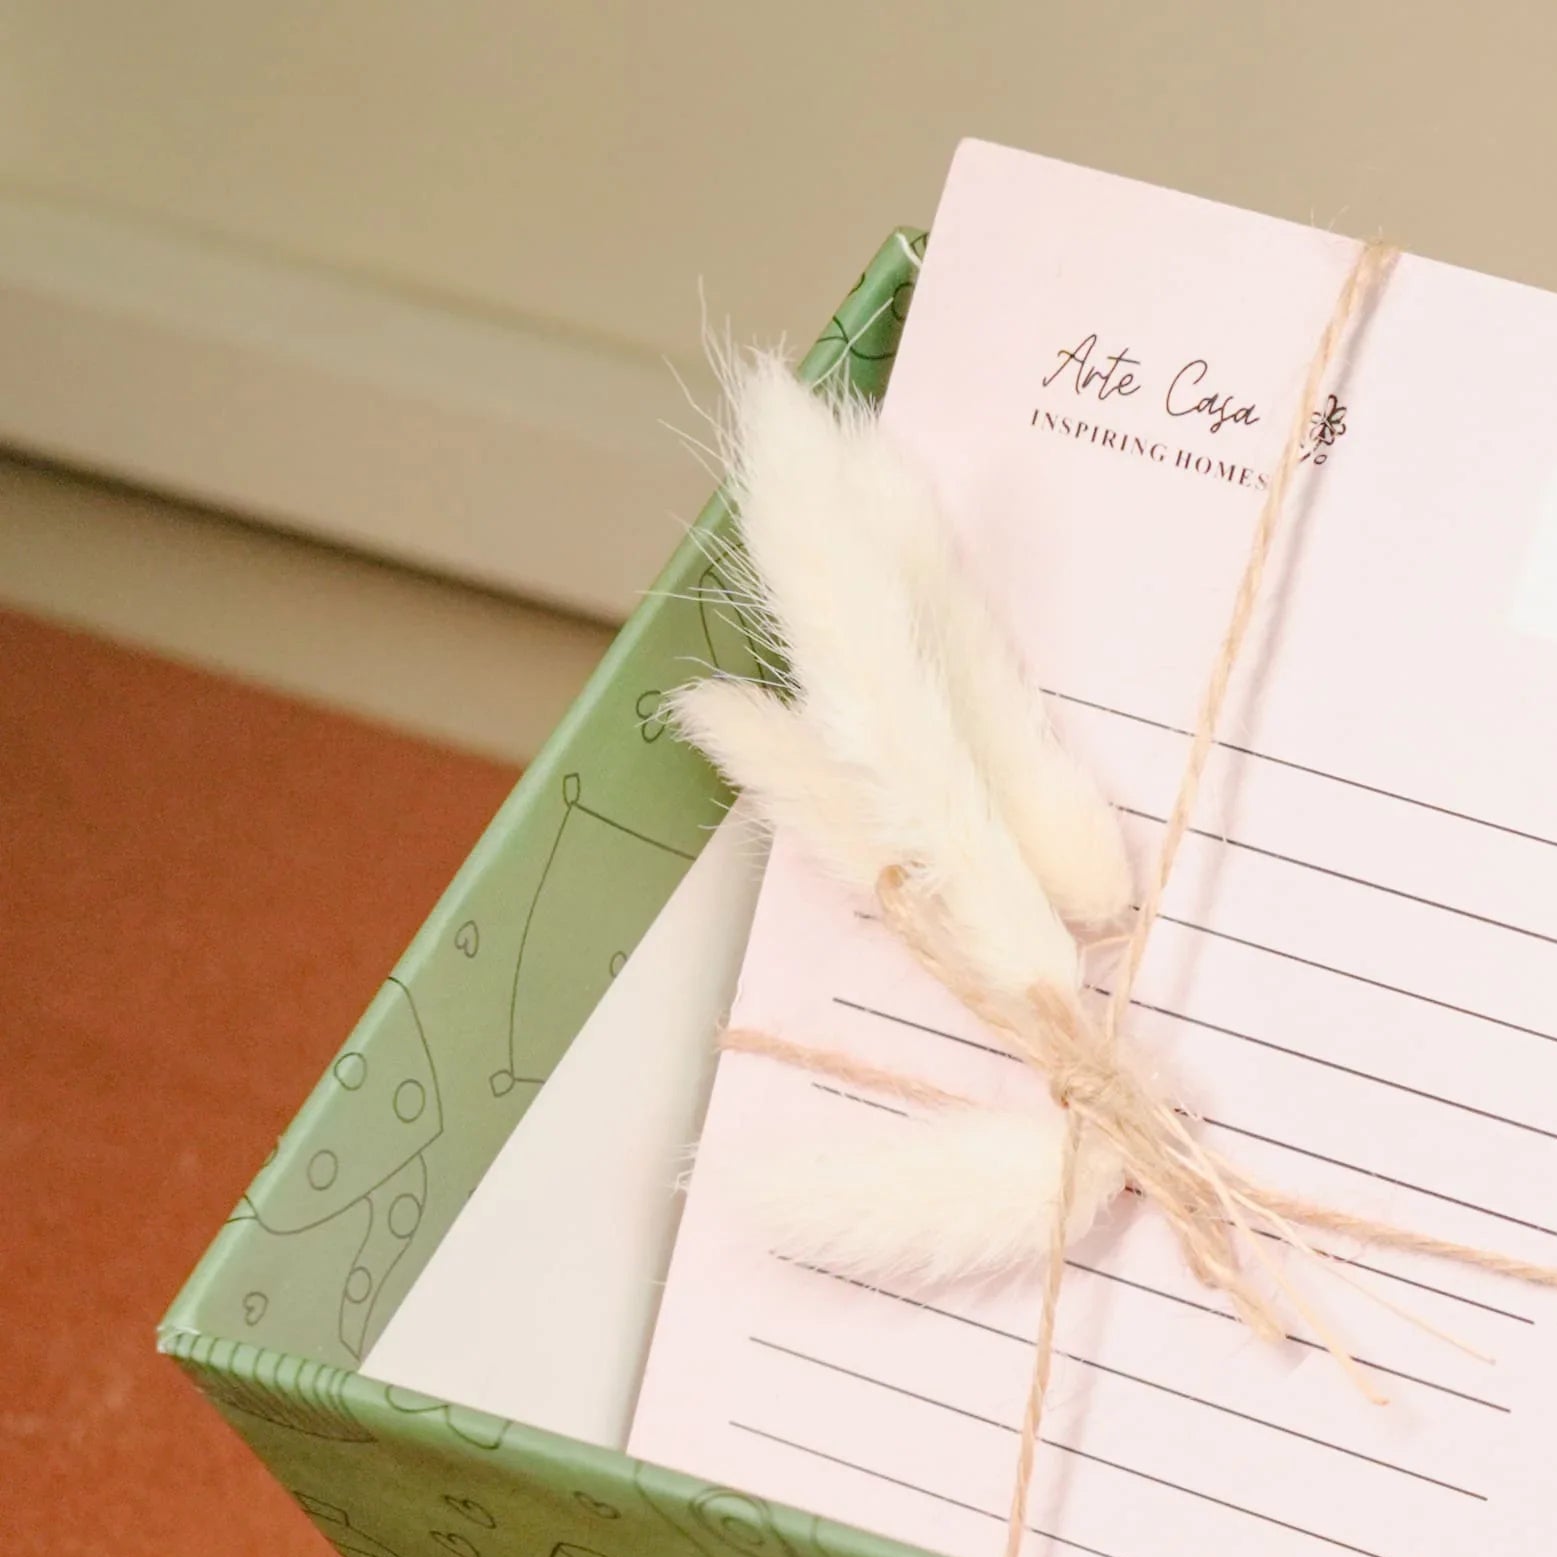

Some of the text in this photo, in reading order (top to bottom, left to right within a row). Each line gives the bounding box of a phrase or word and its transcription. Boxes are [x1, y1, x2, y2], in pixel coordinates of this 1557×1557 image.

[1042, 333, 1260, 433] Arte Casa
[1031, 408, 1270, 491] INSPIRING HOMES
